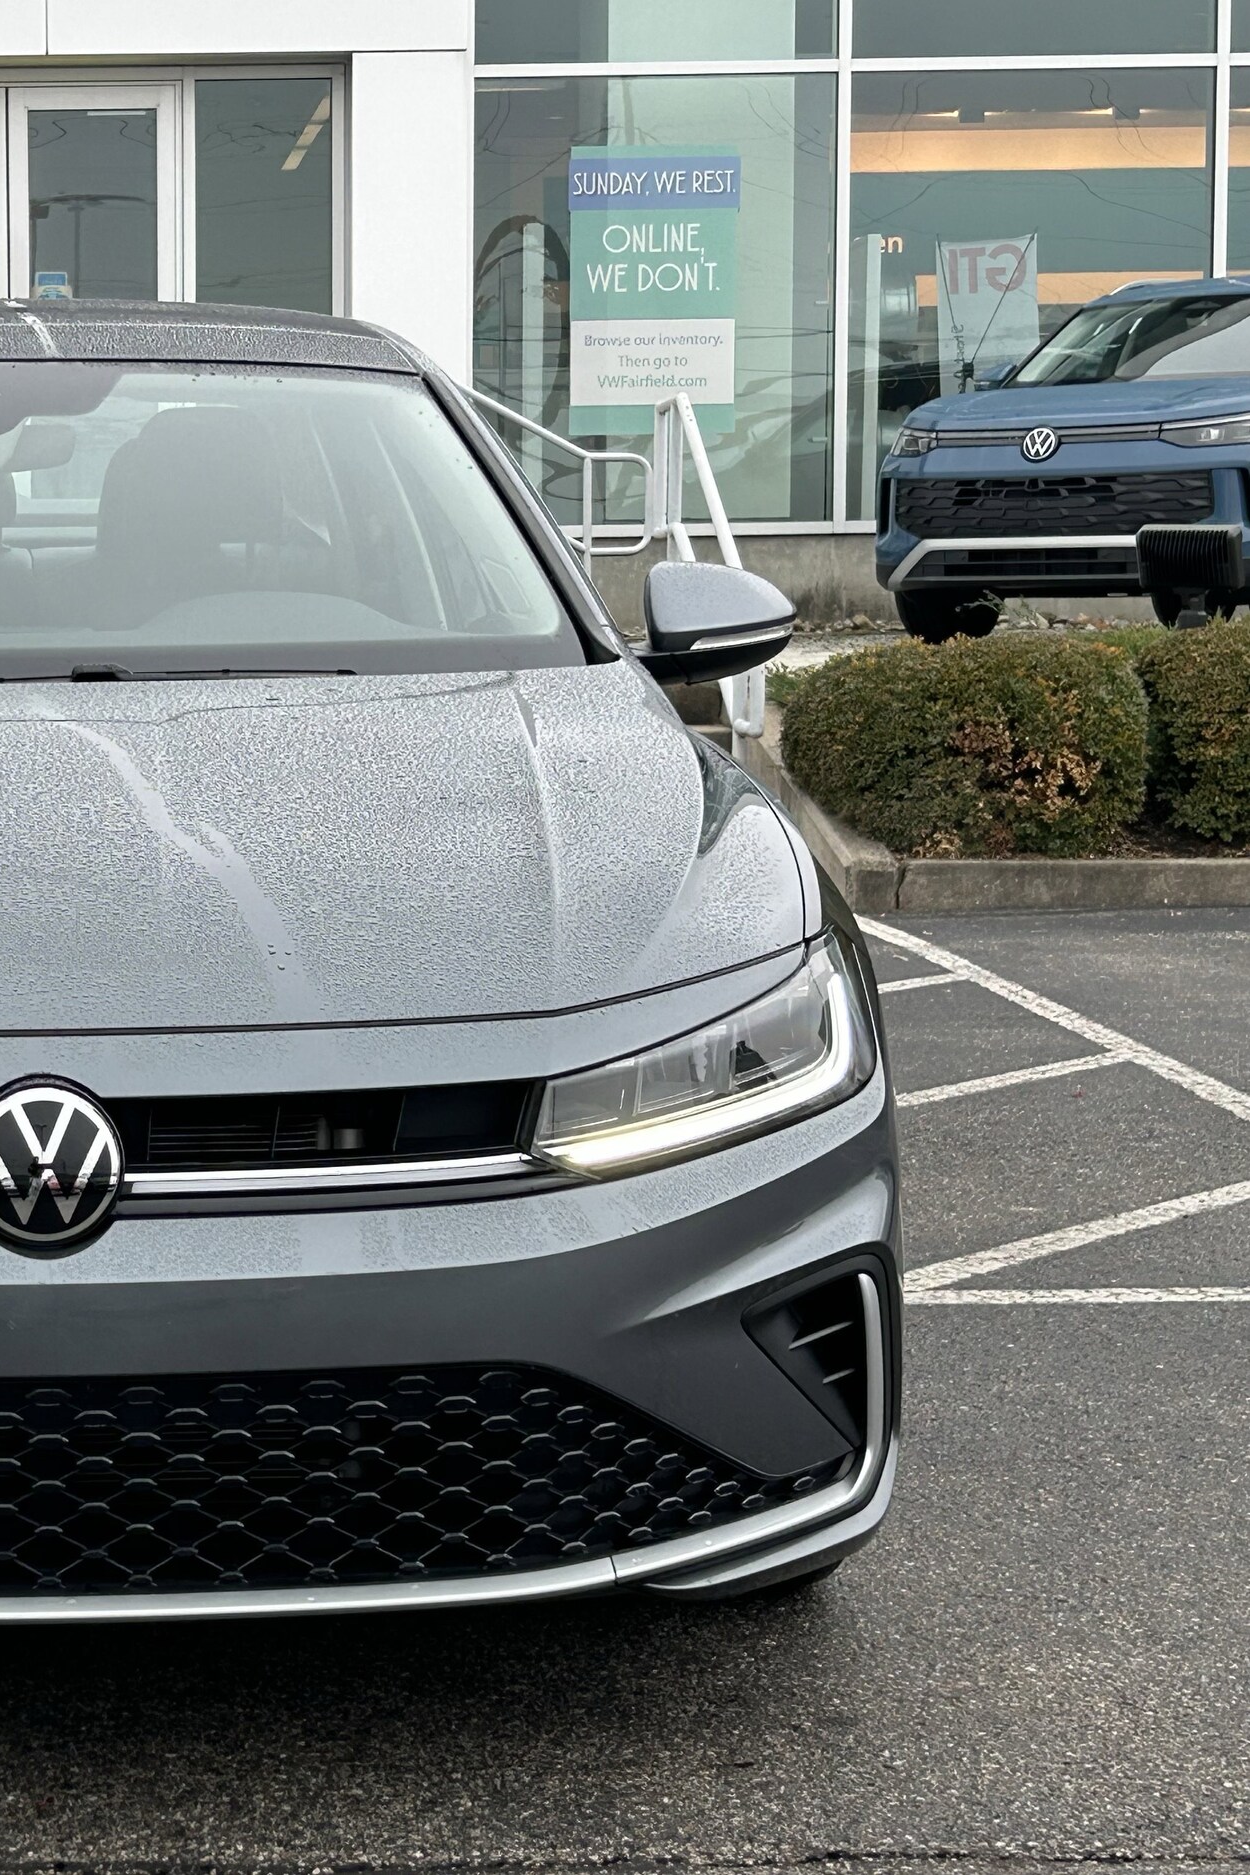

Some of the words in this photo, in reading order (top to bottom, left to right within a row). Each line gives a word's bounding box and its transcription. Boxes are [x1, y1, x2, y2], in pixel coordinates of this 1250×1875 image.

[572, 171, 649, 197] SUNDAY,
[654, 170, 687, 194] WE
[692, 170, 736, 193] REST.
[602, 223, 705, 255] ONLINE,
[586, 263, 628, 293] WE
[638, 256, 721, 292] DON'T.
[584, 334, 631, 347] Browse
[634, 335, 656, 346] our
[618, 355, 651, 367] Then
[653, 358, 671, 370] go
[674, 355, 688, 367] to
[597, 374, 707, 388] VWFairfield.com
